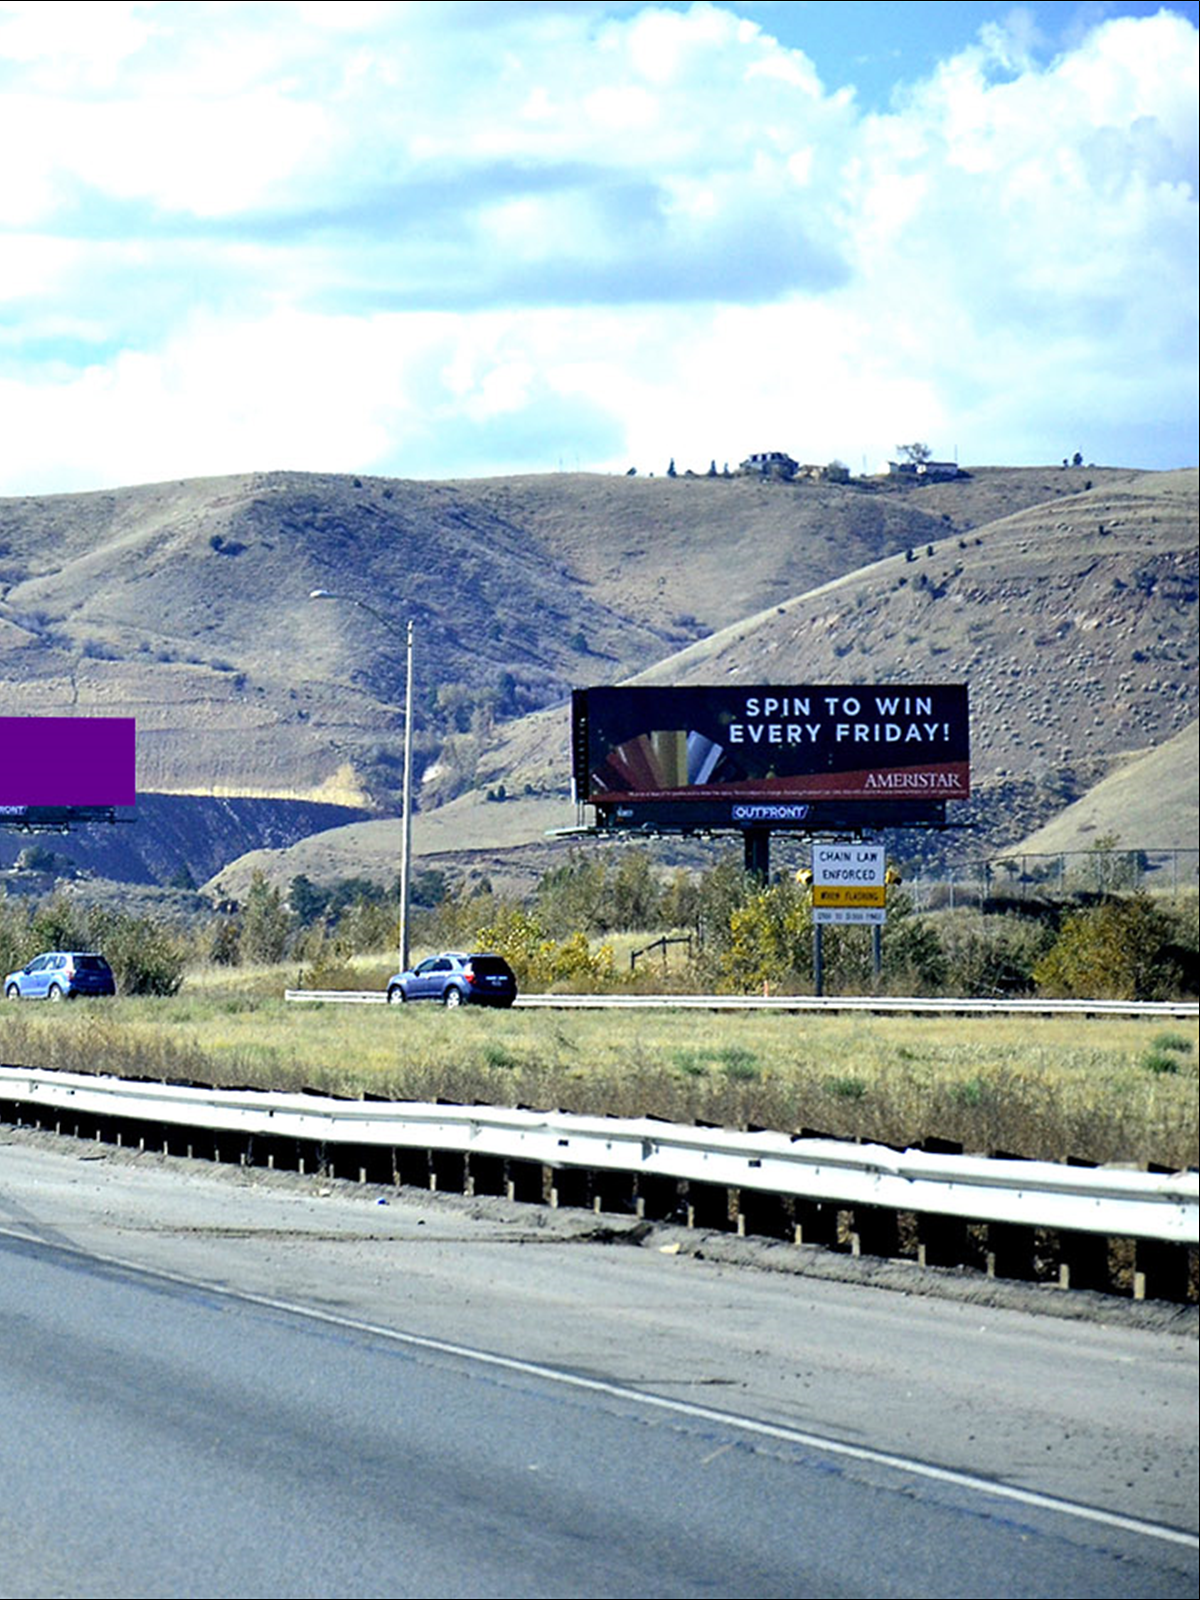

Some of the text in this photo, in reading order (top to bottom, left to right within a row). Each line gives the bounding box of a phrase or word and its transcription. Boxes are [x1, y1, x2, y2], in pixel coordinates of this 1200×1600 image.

[746, 696, 932, 716] SPIN TO WIN
[729, 722, 949, 743] EVERY FRIDAY!
[864, 773, 962, 789] AMERISTAR
[735, 806, 805, 819] OUTFRONT
[819, 851, 878, 862] CHAIN LAW
[822, 869, 876, 881] ENFORCED
